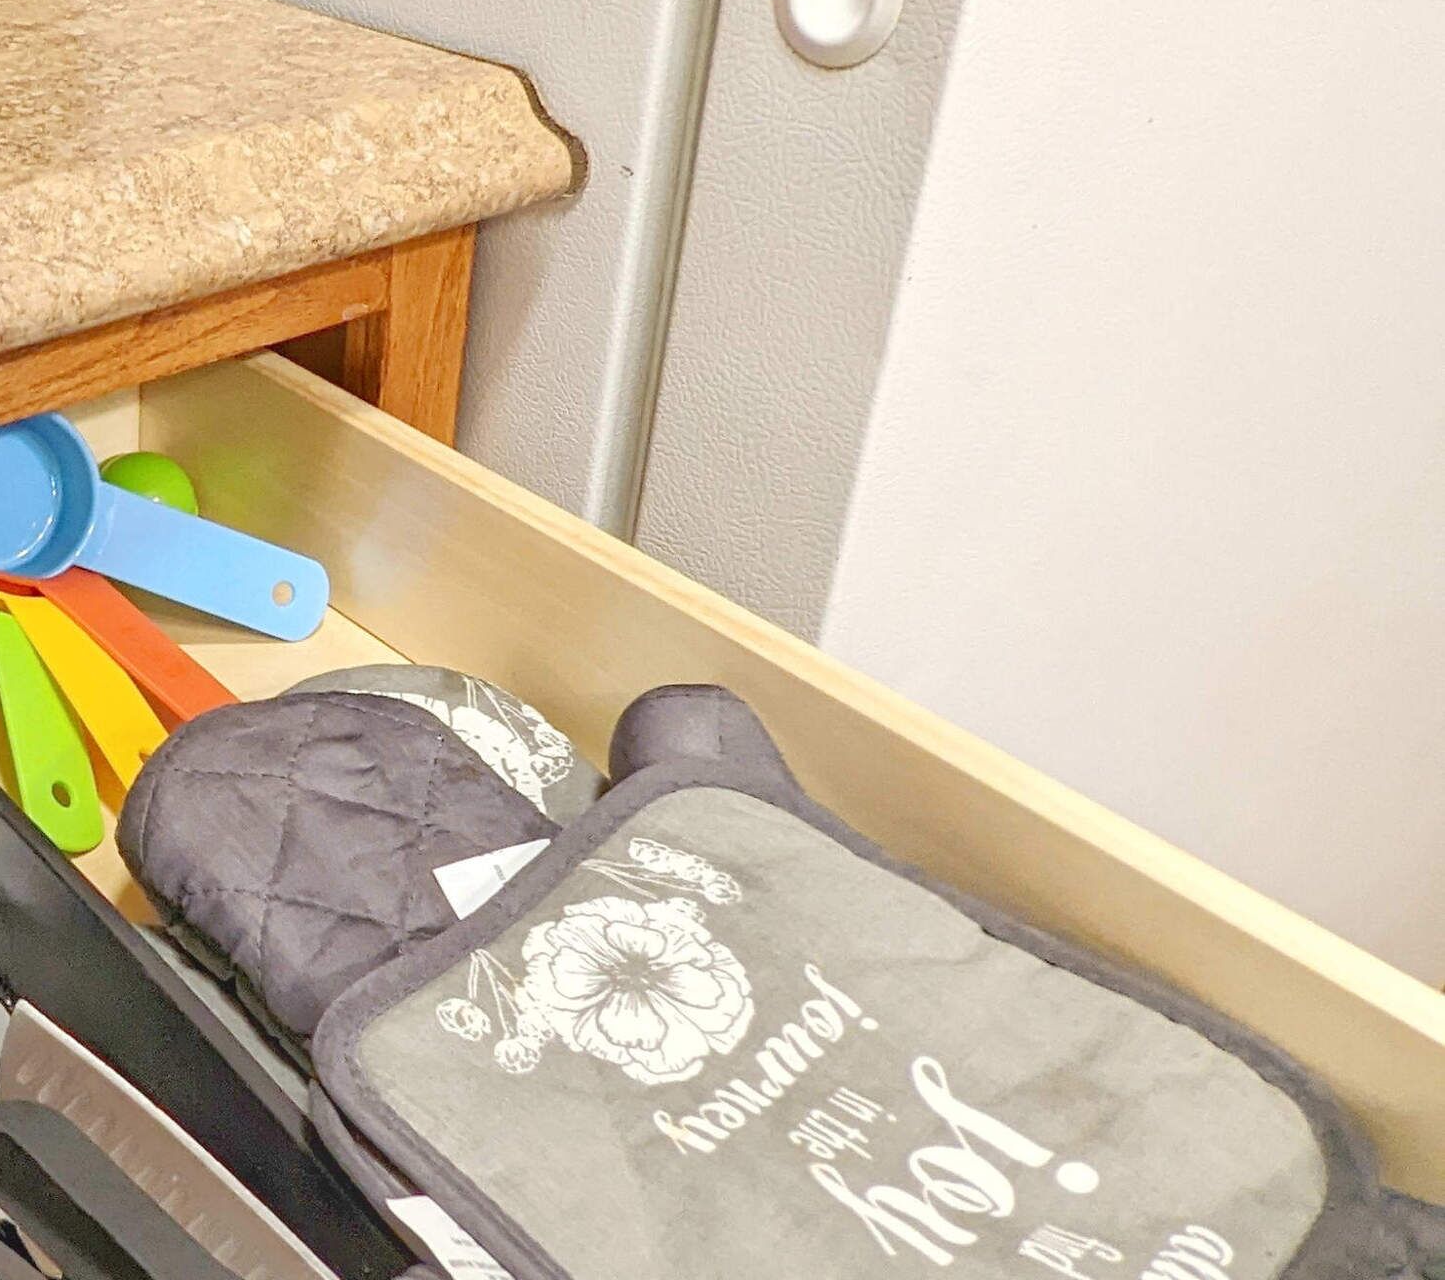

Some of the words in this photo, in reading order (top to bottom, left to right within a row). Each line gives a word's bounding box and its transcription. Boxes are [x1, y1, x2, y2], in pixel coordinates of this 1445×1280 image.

[653, 963, 880, 1154] journey
[828, 1086, 898, 1123] in
[788, 1109, 873, 1160] the
[809, 1055, 1100, 1267] joy
